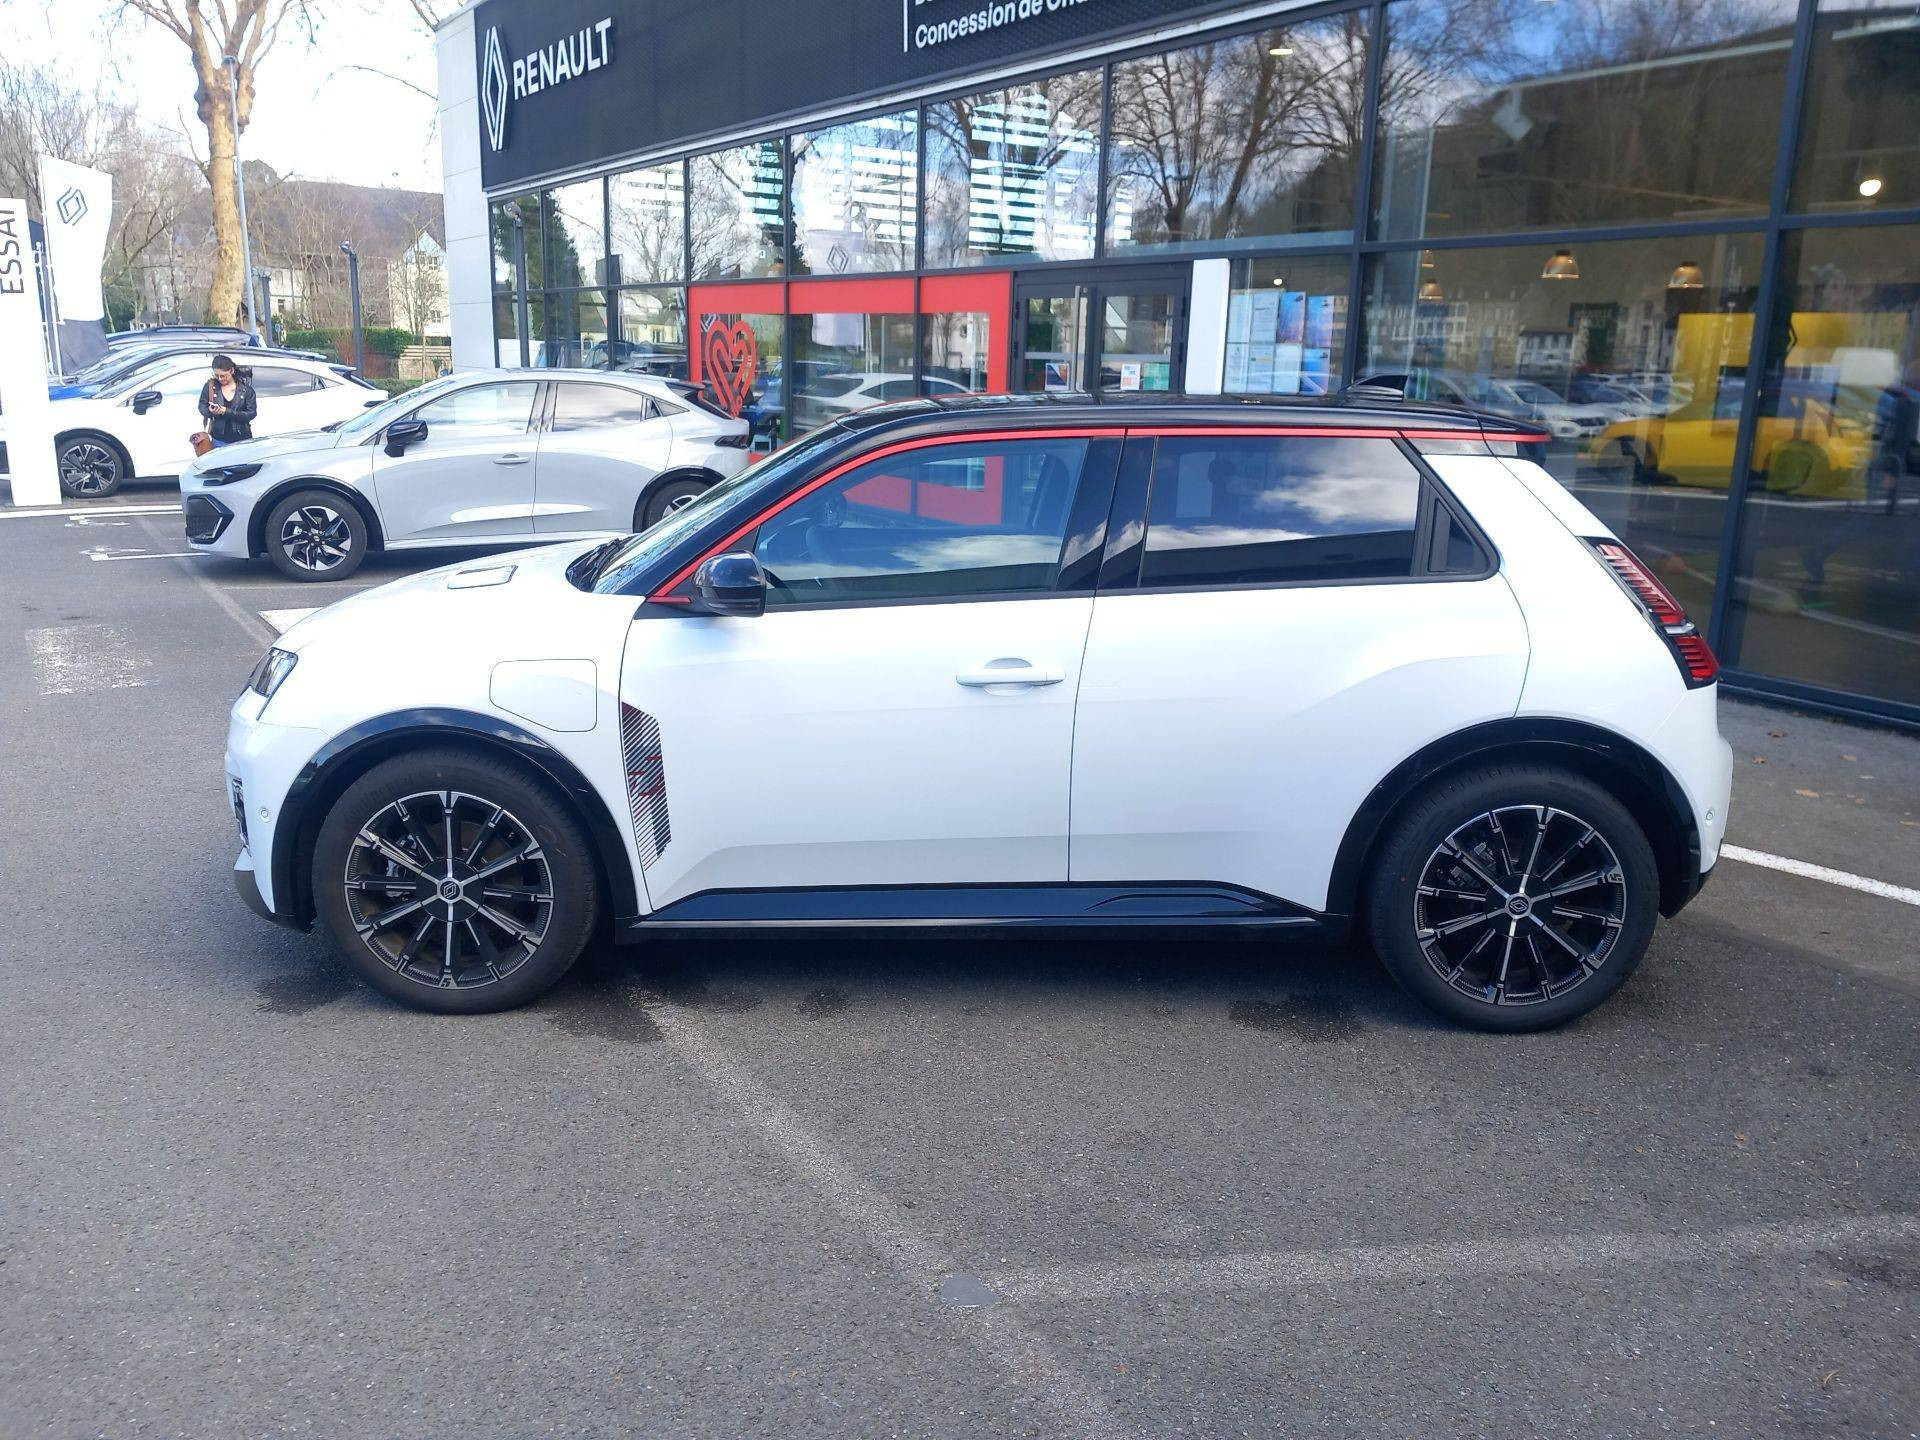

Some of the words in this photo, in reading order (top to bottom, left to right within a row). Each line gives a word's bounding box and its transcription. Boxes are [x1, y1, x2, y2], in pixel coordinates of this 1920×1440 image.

[512, 16, 612, 101] RENAULT
[915, 2, 1015, 48] Concession
[1018, 0, 1043, 19] de
[0, 211, 24, 294] ESSAI
